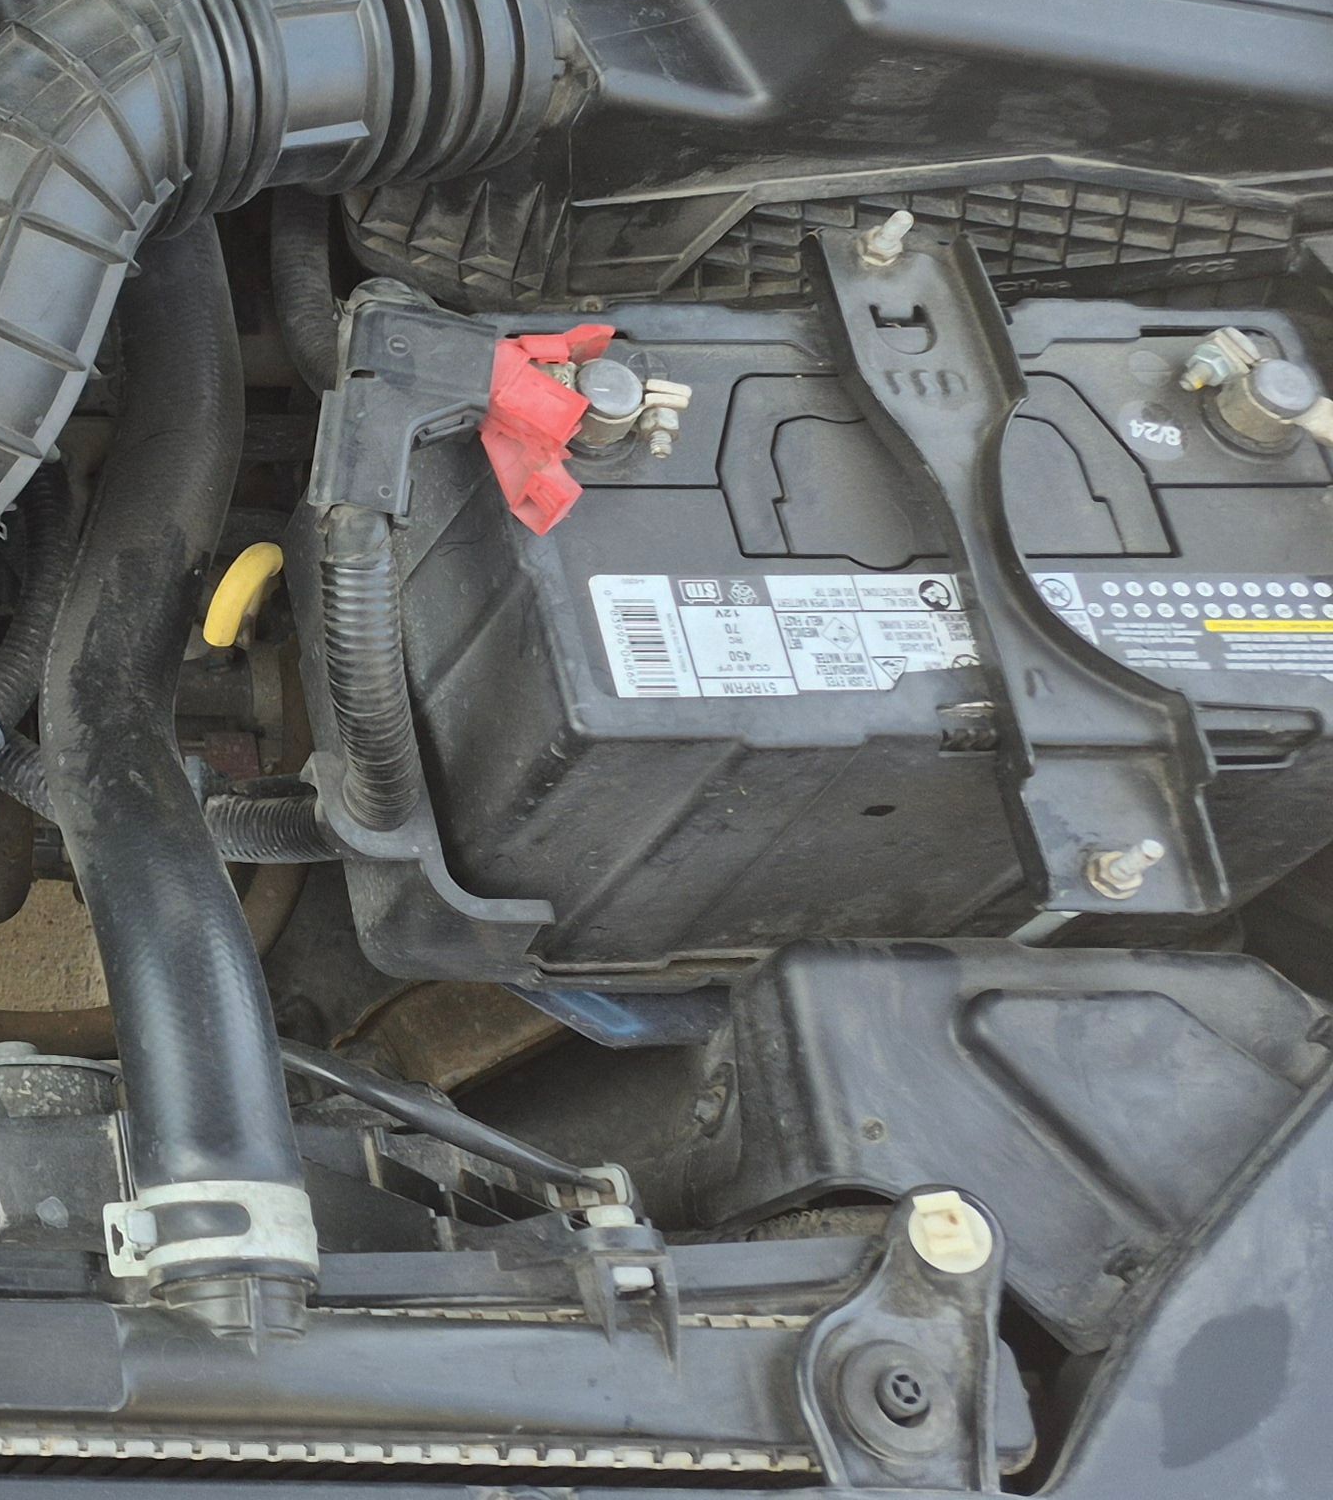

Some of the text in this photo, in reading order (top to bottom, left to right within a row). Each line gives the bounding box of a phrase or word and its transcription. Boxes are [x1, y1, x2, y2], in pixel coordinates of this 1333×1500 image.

[1129, 419, 1182, 446] 8/24
[715, 609, 740, 618] 12V
[724, 623, 740, 634] 70
[728, 651, 751, 661] 450
